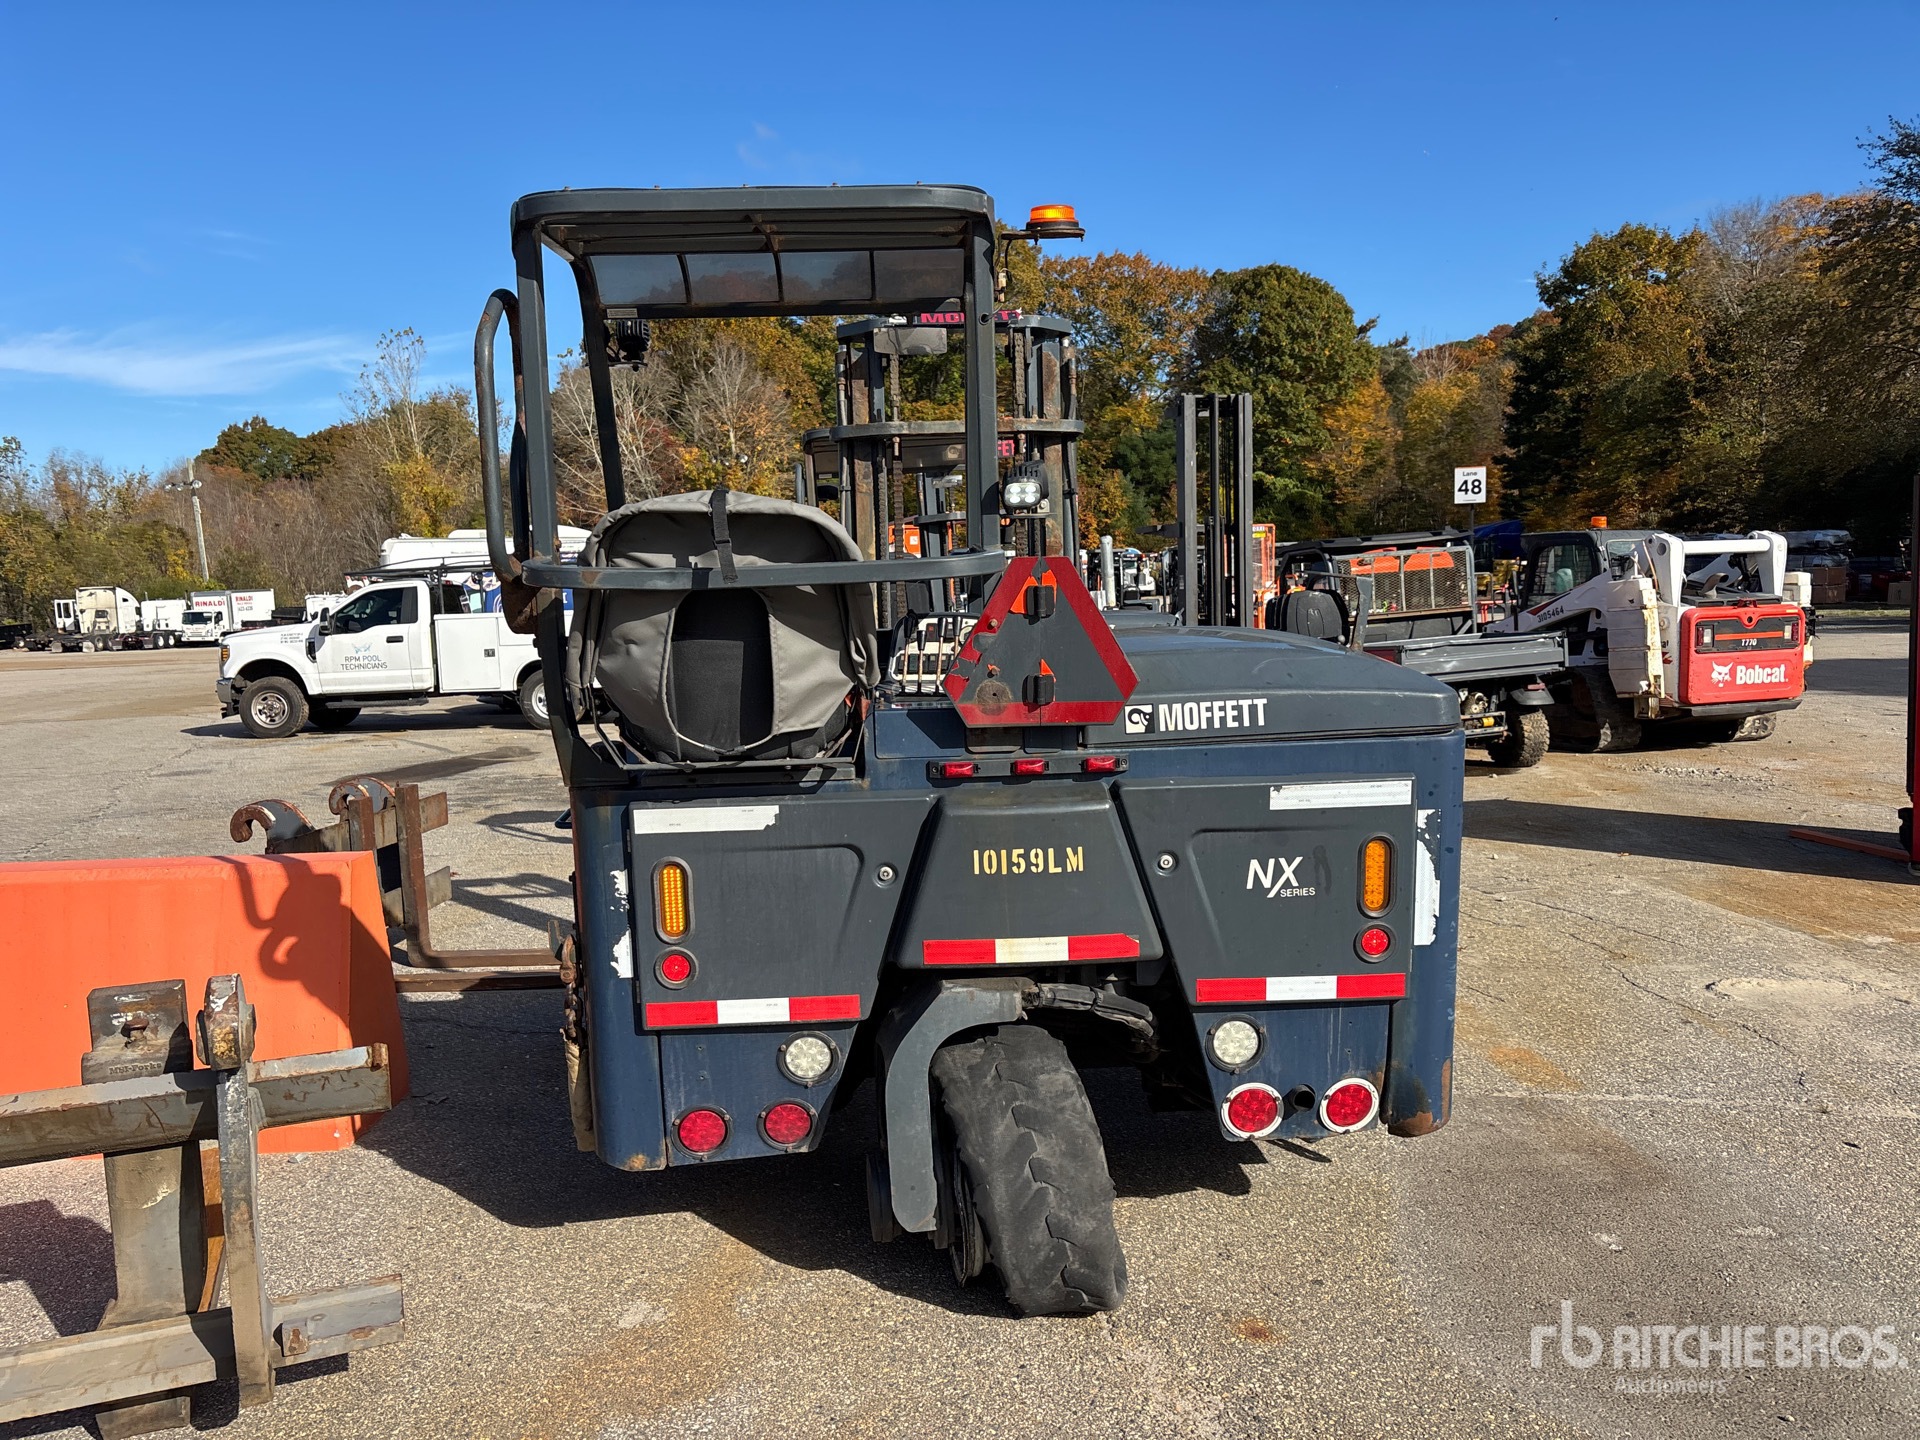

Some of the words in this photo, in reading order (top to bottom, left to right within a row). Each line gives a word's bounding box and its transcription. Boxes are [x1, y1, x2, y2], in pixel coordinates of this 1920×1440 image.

[1457, 478, 1482, 495] 48
[1741, 638, 1758, 647] T770
[340, 661, 388, 671] TECHNICIANS
[344, 655, 361, 663] RPM
[1158, 698, 1268, 732] MOFFETT
[973, 846, 1084, 875] 10159LM
[1246, 856, 1304, 899] NX
[1280, 887, 1316, 898] SERIES
